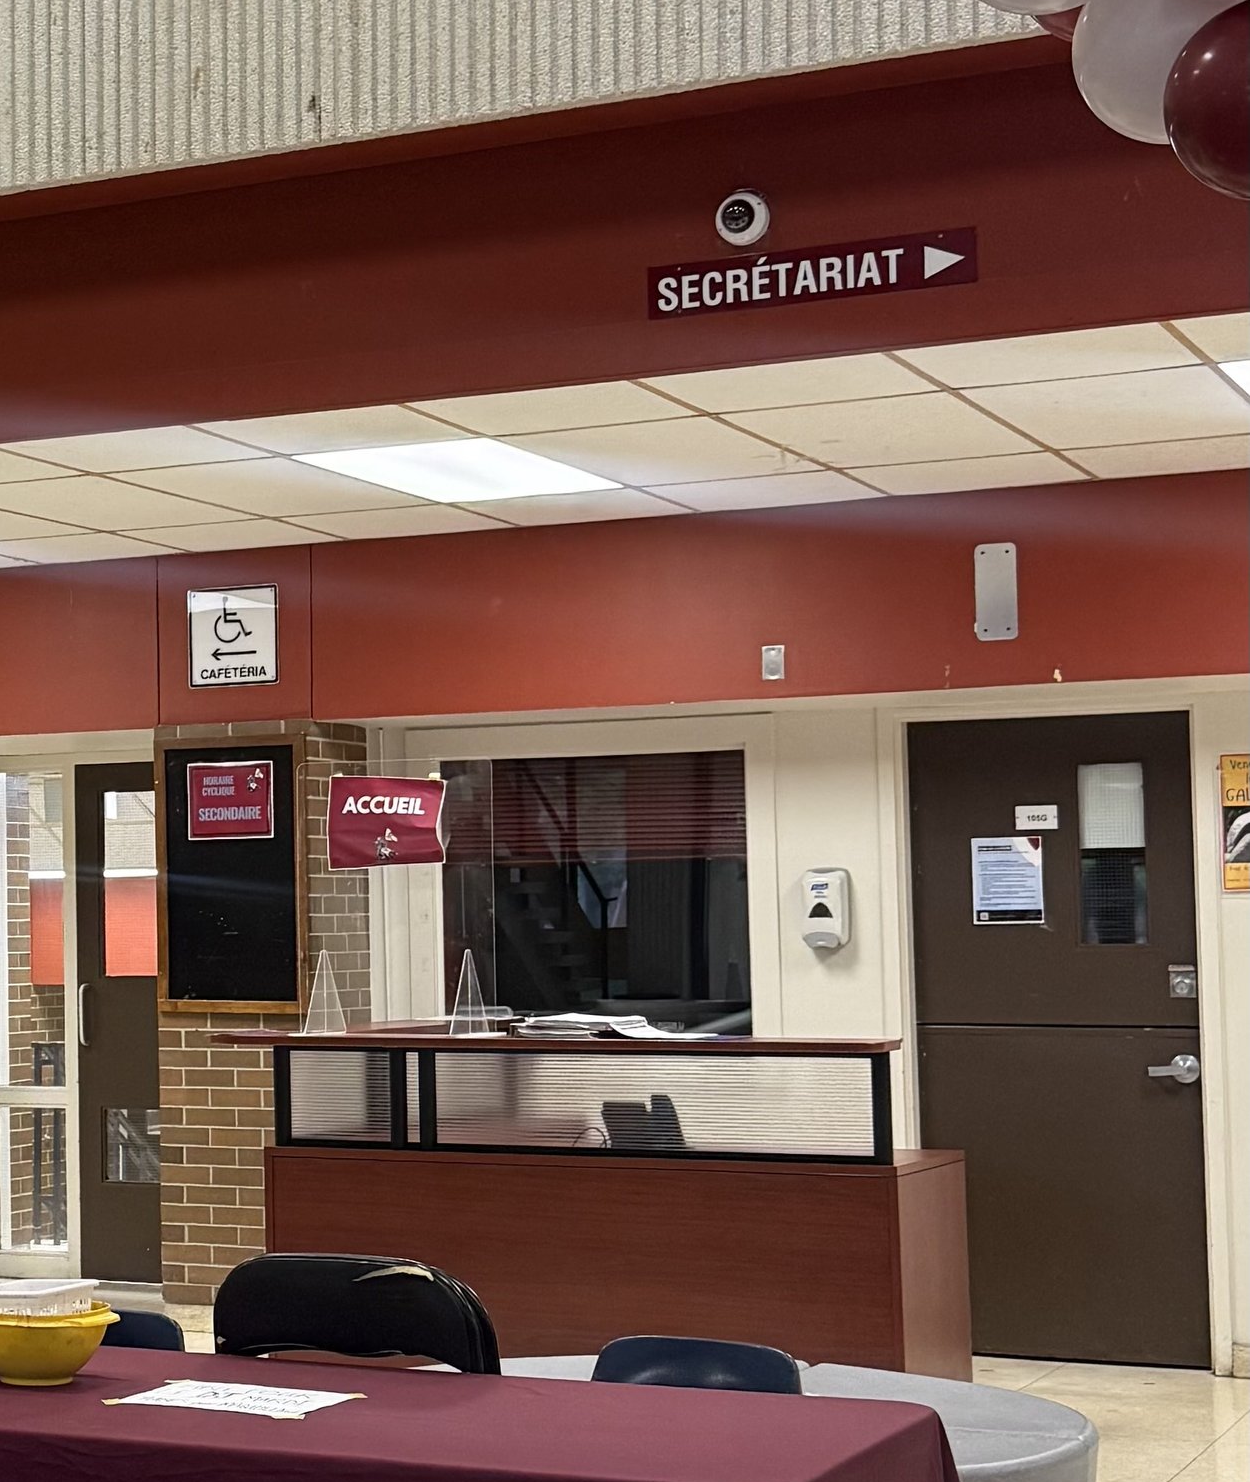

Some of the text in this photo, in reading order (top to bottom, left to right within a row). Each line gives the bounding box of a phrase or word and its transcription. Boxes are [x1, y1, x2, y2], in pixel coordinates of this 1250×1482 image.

[657, 248, 904, 312] SECRÉTARIAT
[200, 665, 267, 680] CAFÉTÉRIA
[198, 806, 262, 821] SECONDAIRE
[342, 795, 425, 815] ACCUEIL
